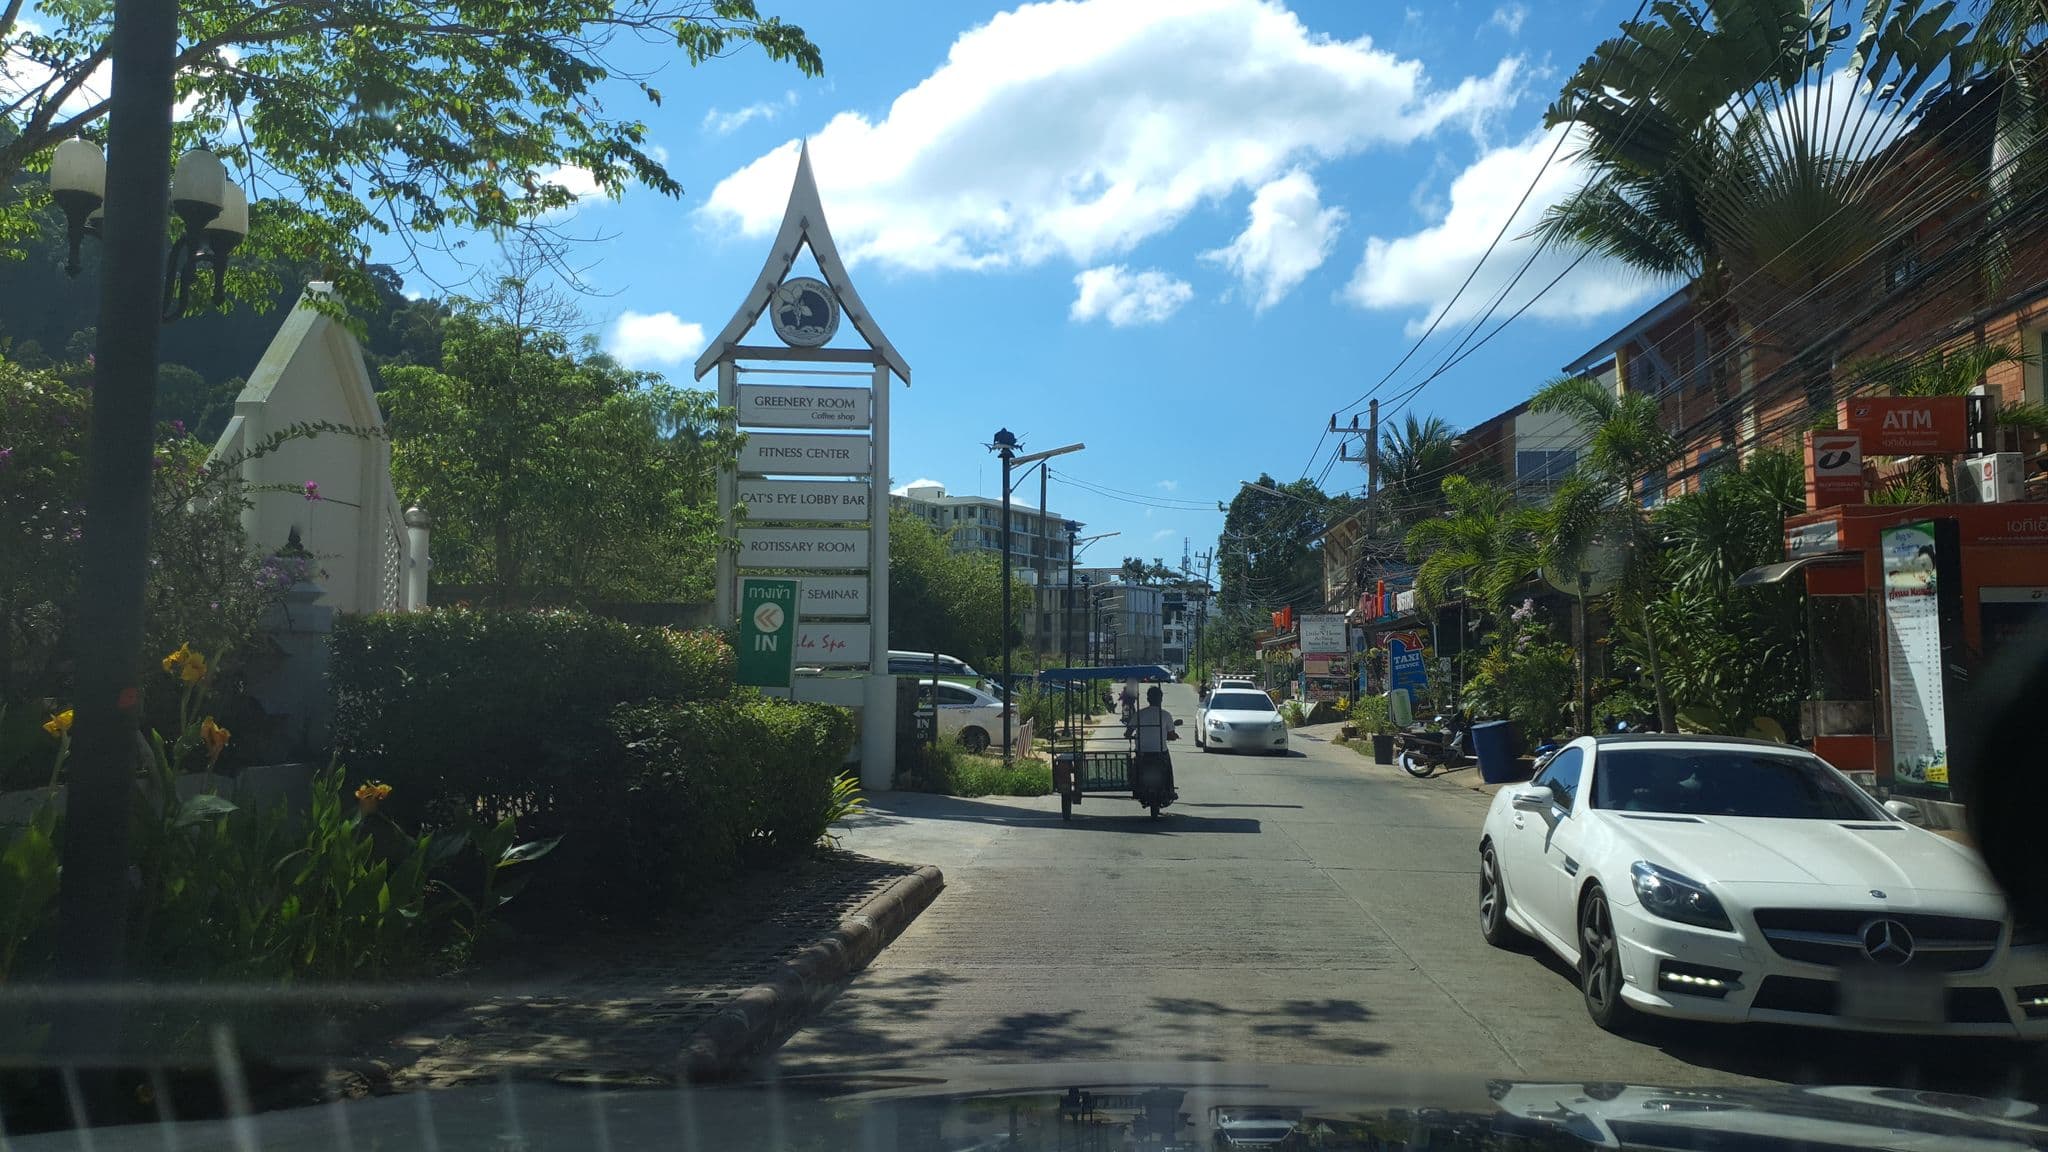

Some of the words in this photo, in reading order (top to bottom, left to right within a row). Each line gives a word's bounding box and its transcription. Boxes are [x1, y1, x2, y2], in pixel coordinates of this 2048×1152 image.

[754, 395, 814, 408] GREENERY
[817, 397, 856, 409] ROOM
[811, 411, 836, 420] Coffee
[837, 412, 856, 422] shop
[1882, 409, 1933, 429] ATM
[759, 446, 803, 458] FITNESS
[806, 448, 850, 459] CENTER
[740, 493, 773, 504] CAT'S
[777, 494, 798, 504] EYE
[800, 494, 839, 505] LOBBY
[842, 495, 866, 506] BAR
[751, 541, 814, 552] ROTISSARY
[817, 542, 856, 553] ROOM
[749, 584, 791, 600] ทางเข้า
[808, 589, 860, 600] SEMINAR
[755, 634, 778, 652] IN
[821, 634, 847, 652] Spa
[1394, 653, 1420, 664] TAXI
[917, 719, 929, 729] IN
